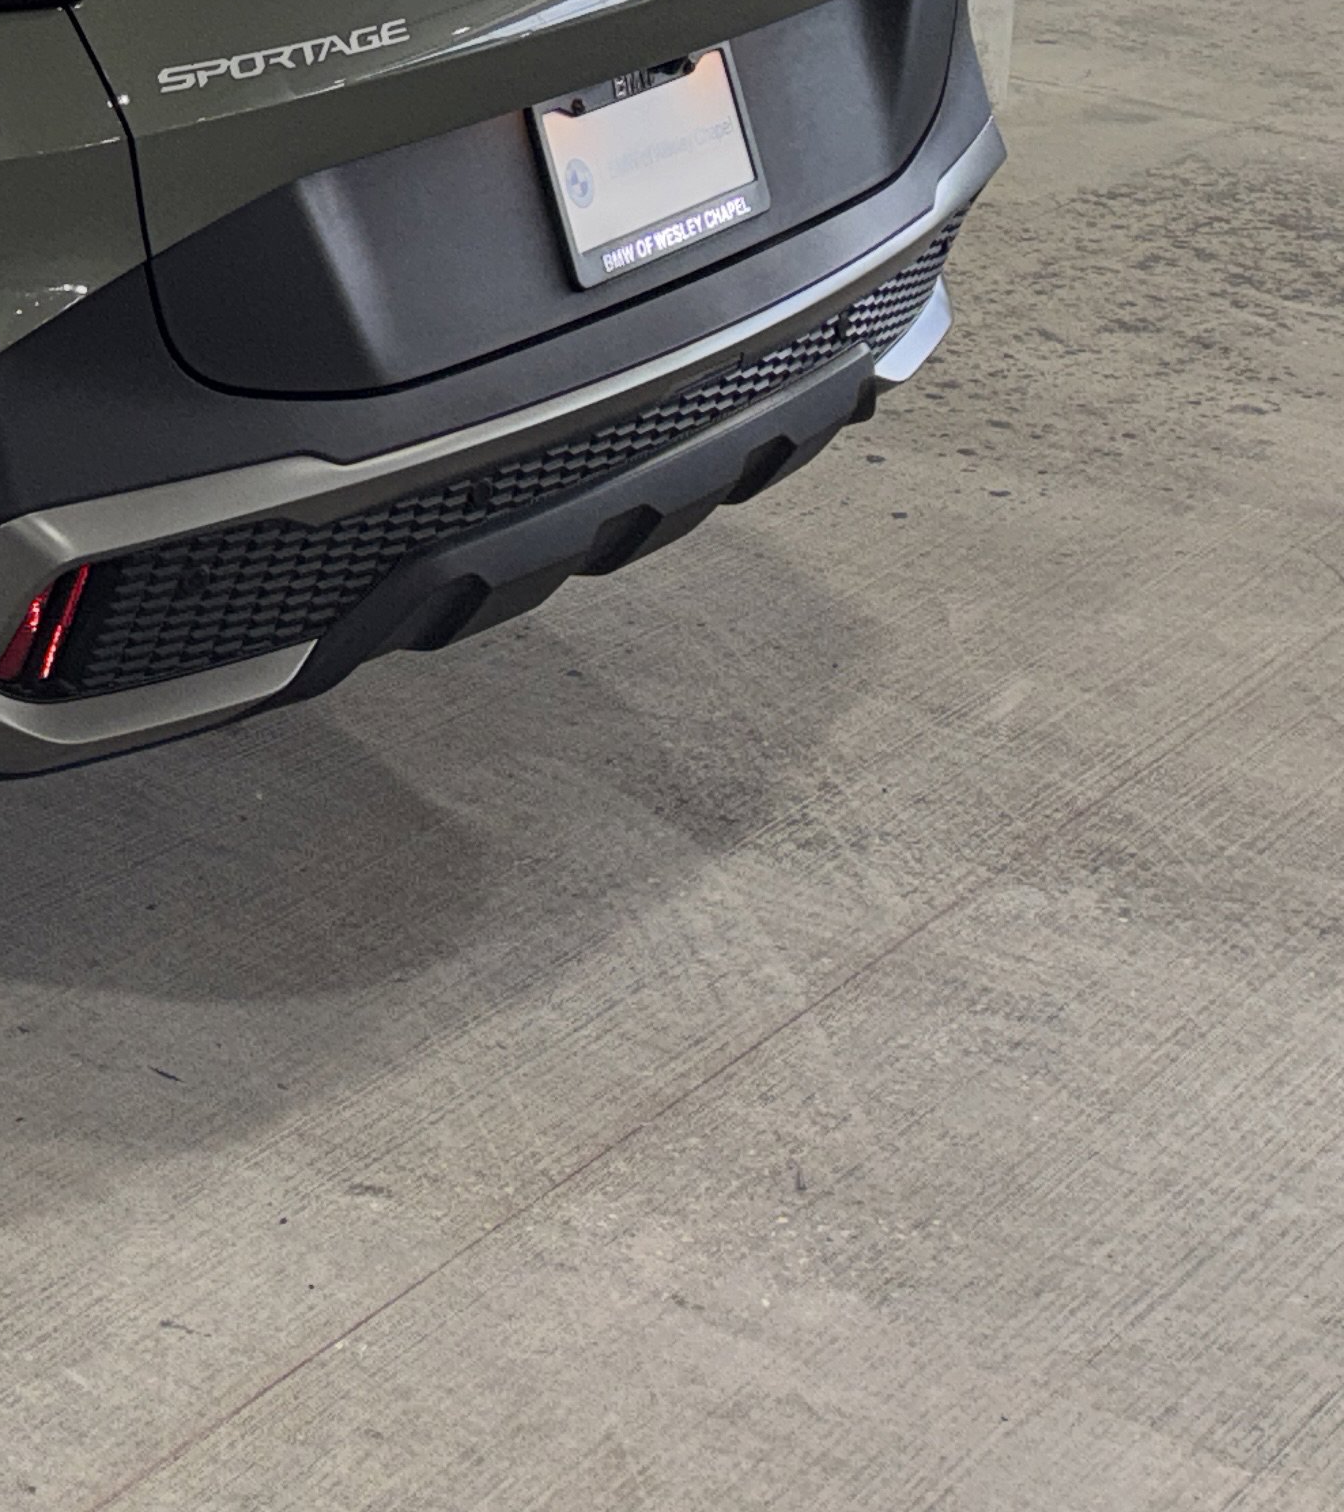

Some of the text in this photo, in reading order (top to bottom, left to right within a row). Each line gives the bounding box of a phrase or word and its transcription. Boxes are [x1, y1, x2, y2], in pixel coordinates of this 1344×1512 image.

[158, 18, 410, 93] SPORTAGE
[602, 196, 752, 273] BMW OF WESLEY CHAPEL
